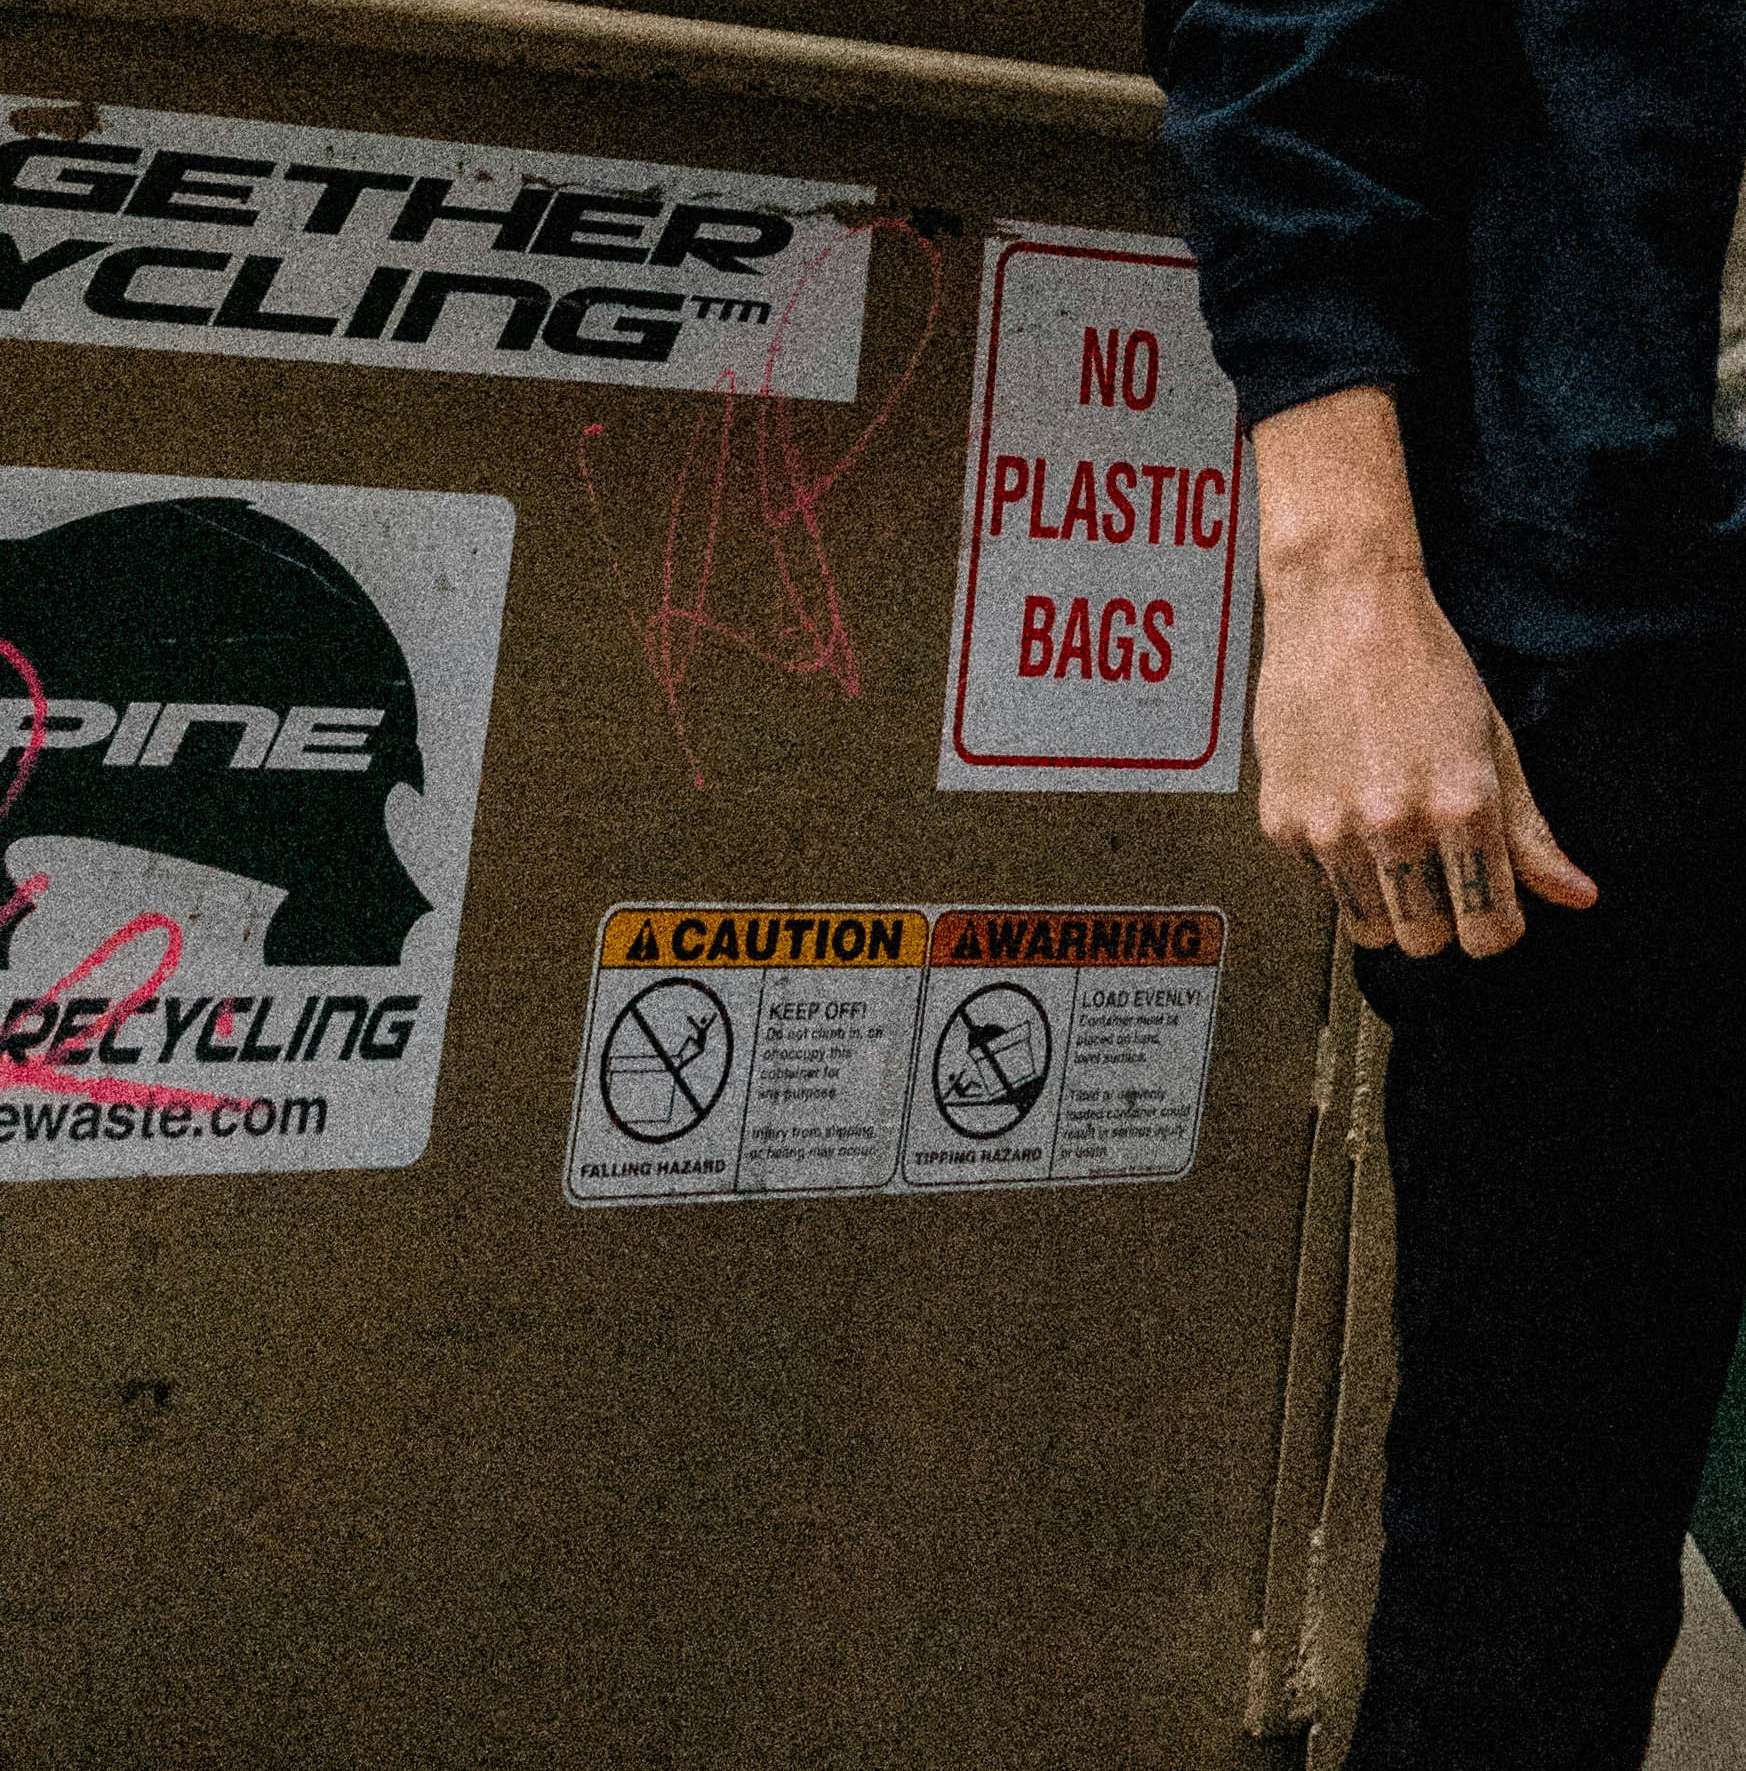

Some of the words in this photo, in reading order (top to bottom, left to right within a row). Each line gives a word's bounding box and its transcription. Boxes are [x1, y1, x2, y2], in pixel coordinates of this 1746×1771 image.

[0, 137, 794, 275] GETHER
[1079, 325, 1159, 411] NO
[990, 454, 1225, 549] PLASTIC
[1018, 594, 1175, 683] BAGS
[671, 918, 905, 961] CAUTION
[986, 919, 1203, 961] WARNING
[768, 1002, 821, 1021] KEEP
[824, 1001, 867, 1021] OFF!
[1081, 990, 1129, 1009] LOAD
[2, 995, 422, 1065] RECYCLING
[0, 1095, 330, 1144] ewaste.com
[579, 1160, 650, 1179] FALLING
[656, 1158, 727, 1177] HAZARD
[914, 1148, 976, 1166] TIPPING
[980, 1146, 1043, 1163] HAZARD
